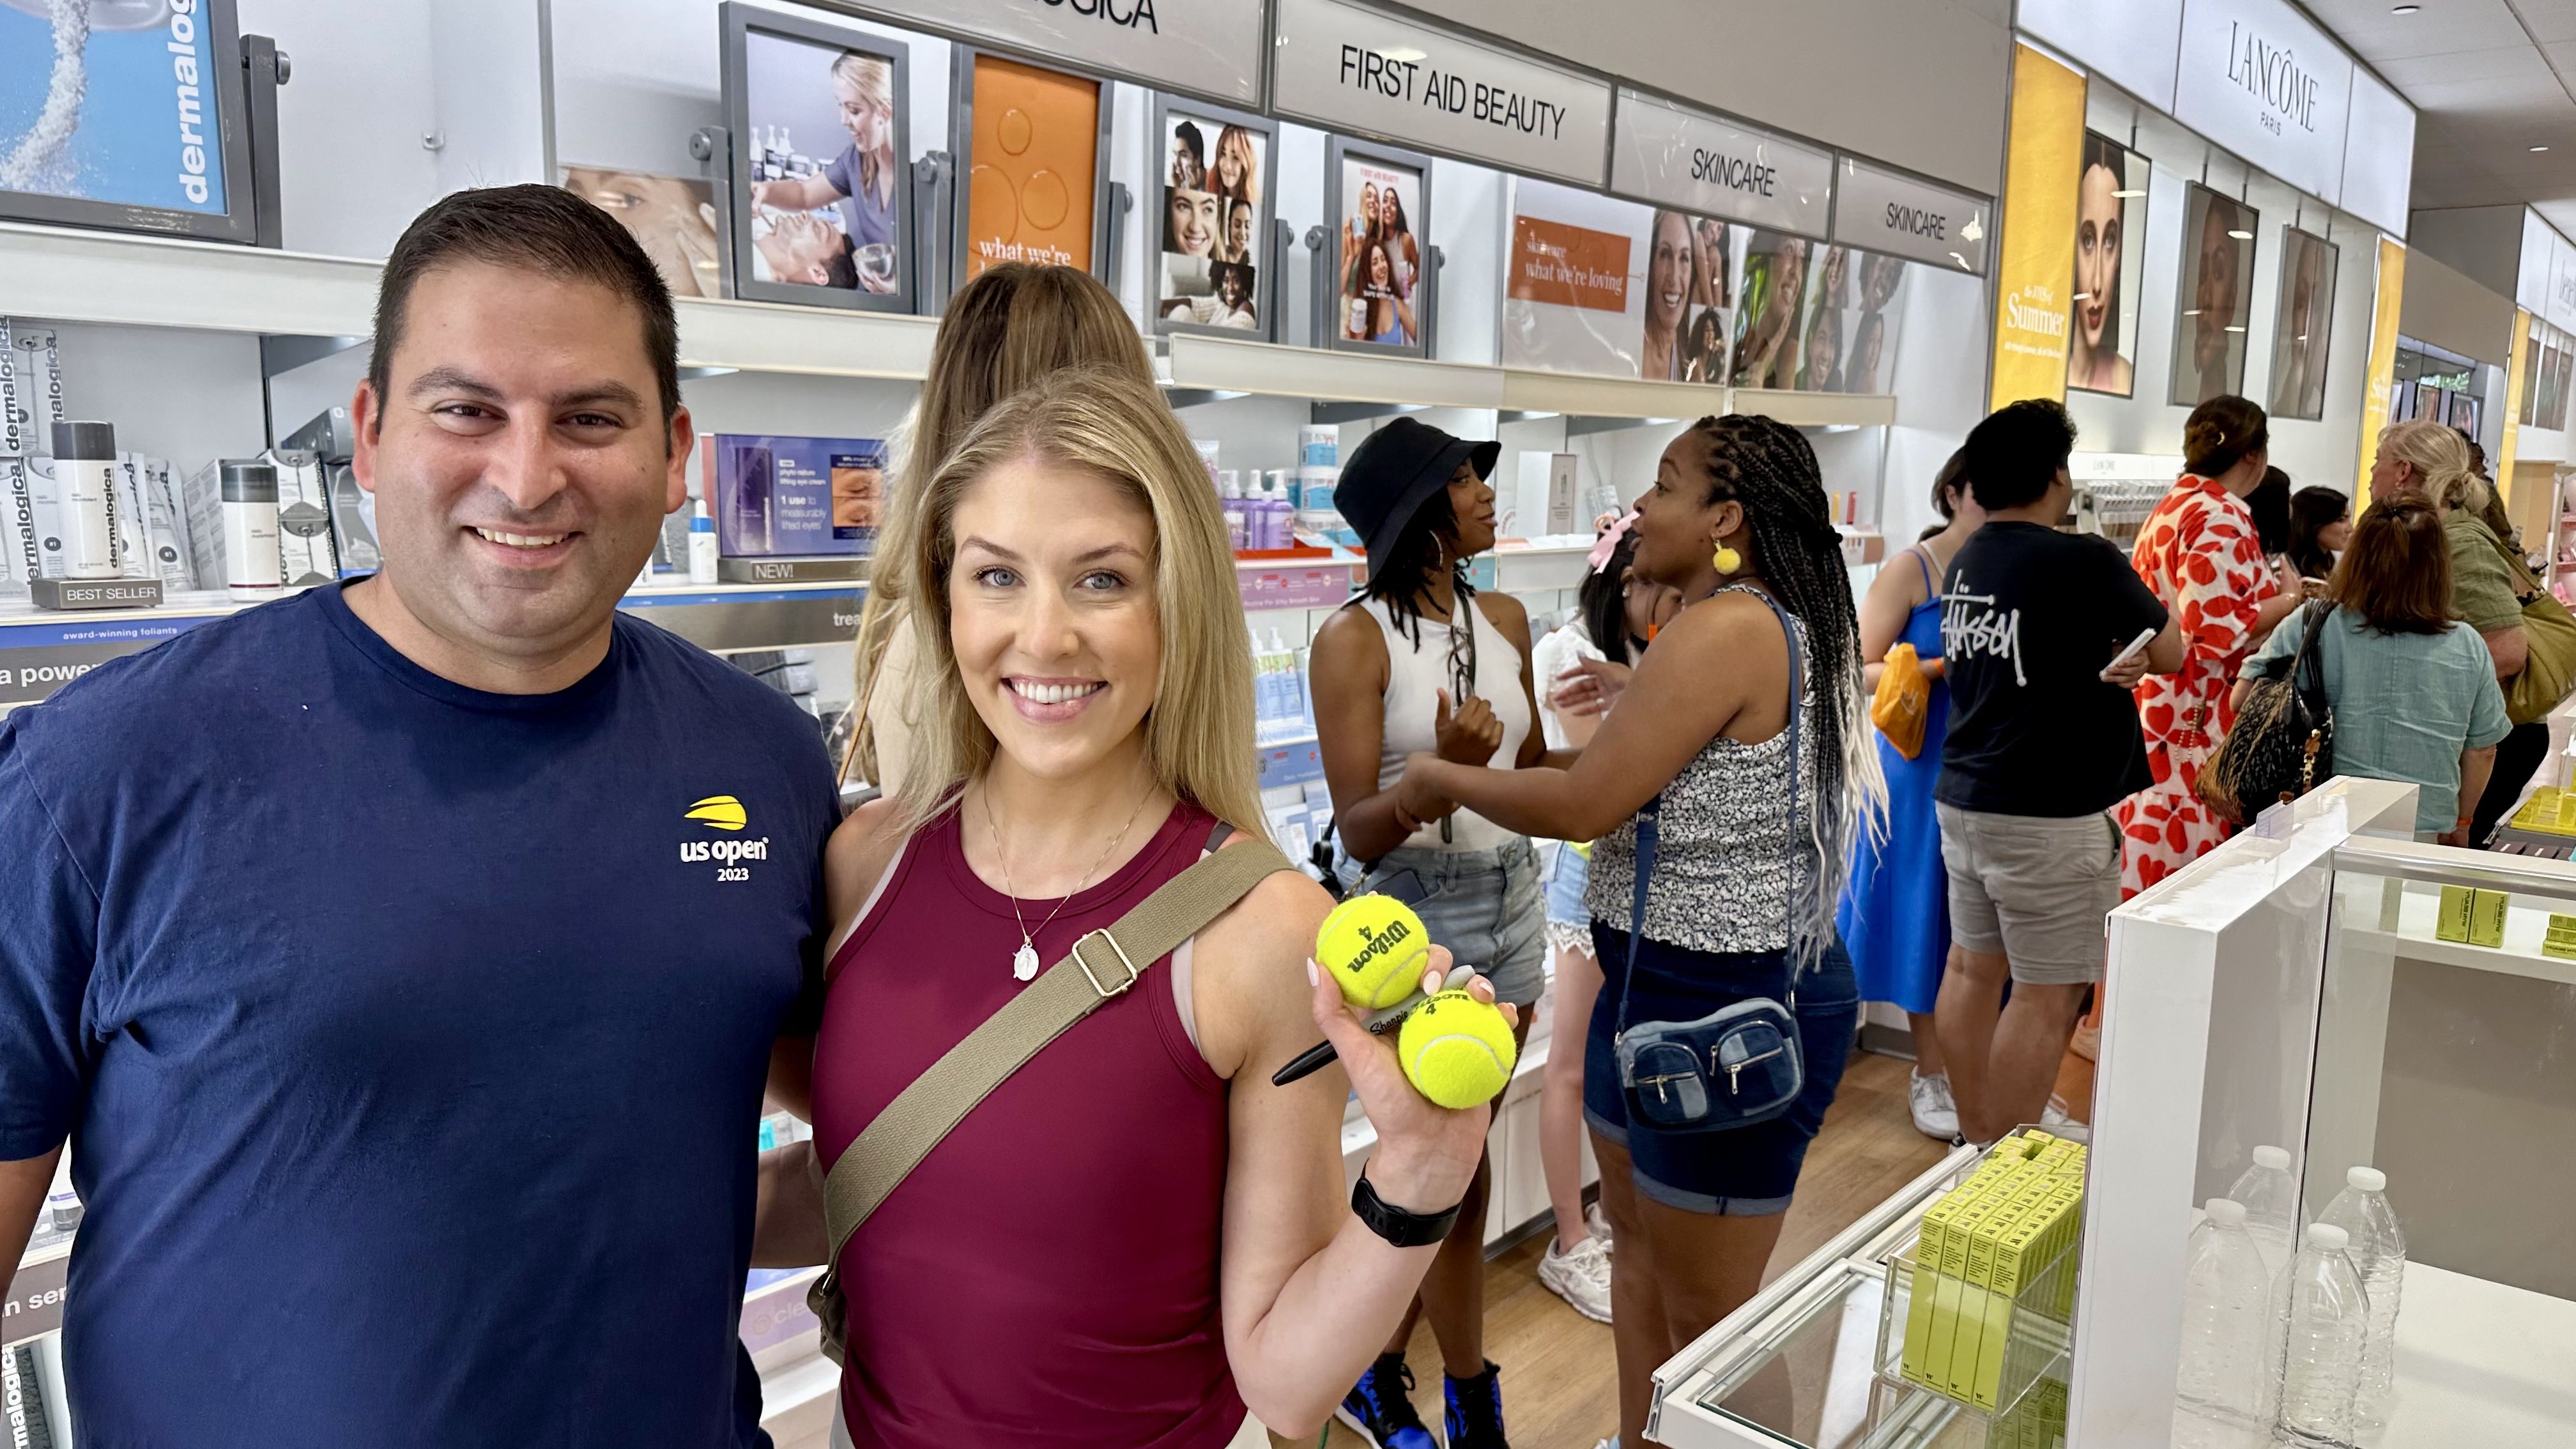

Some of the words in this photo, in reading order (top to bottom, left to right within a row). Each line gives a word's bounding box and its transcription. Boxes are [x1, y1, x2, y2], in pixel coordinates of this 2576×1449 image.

[2228, 20, 2319, 133] LANCÔME
[1341, 44, 1418, 102] FIRST
[1423, 70, 1466, 114] AID
[1474, 83, 1566, 140] BEAUTY
[2260, 111, 2281, 136] PARIS
[1691, 148, 1775, 197] SKINCARE
[1886, 202, 1946, 241] SKINCARE
[979, 236, 1023, 261] what
[1027, 244, 1071, 266] we're
[1525, 258, 1554, 281] what
[1556, 266, 1586, 285] we're
[1588, 267, 1623, 296] loving
[2006, 292, 2065, 337] Summer
[789, 496, 806, 505] use
[10, 464, 40, 585] ermalogica
[103, 468, 118, 569] dermalogica
[755, 564, 793, 579] NEW!
[67, 588, 102, 601] BEST
[107, 586, 157, 600] SELLER
[63, 629, 138, 640] award-winning
[141, 627, 178, 637] foliants
[0, 669, 12, 685] a
[20, 663, 102, 687] powe
[717, 867, 749, 882] 2023
[1347, 920, 1411, 973] Wilson
[1358, 925, 1372, 942] 4
[1370, 1009, 1409, 1036] Sharpie
[3, 1300, 20, 1319] n
[1, 1345, 28, 1449] malogic
